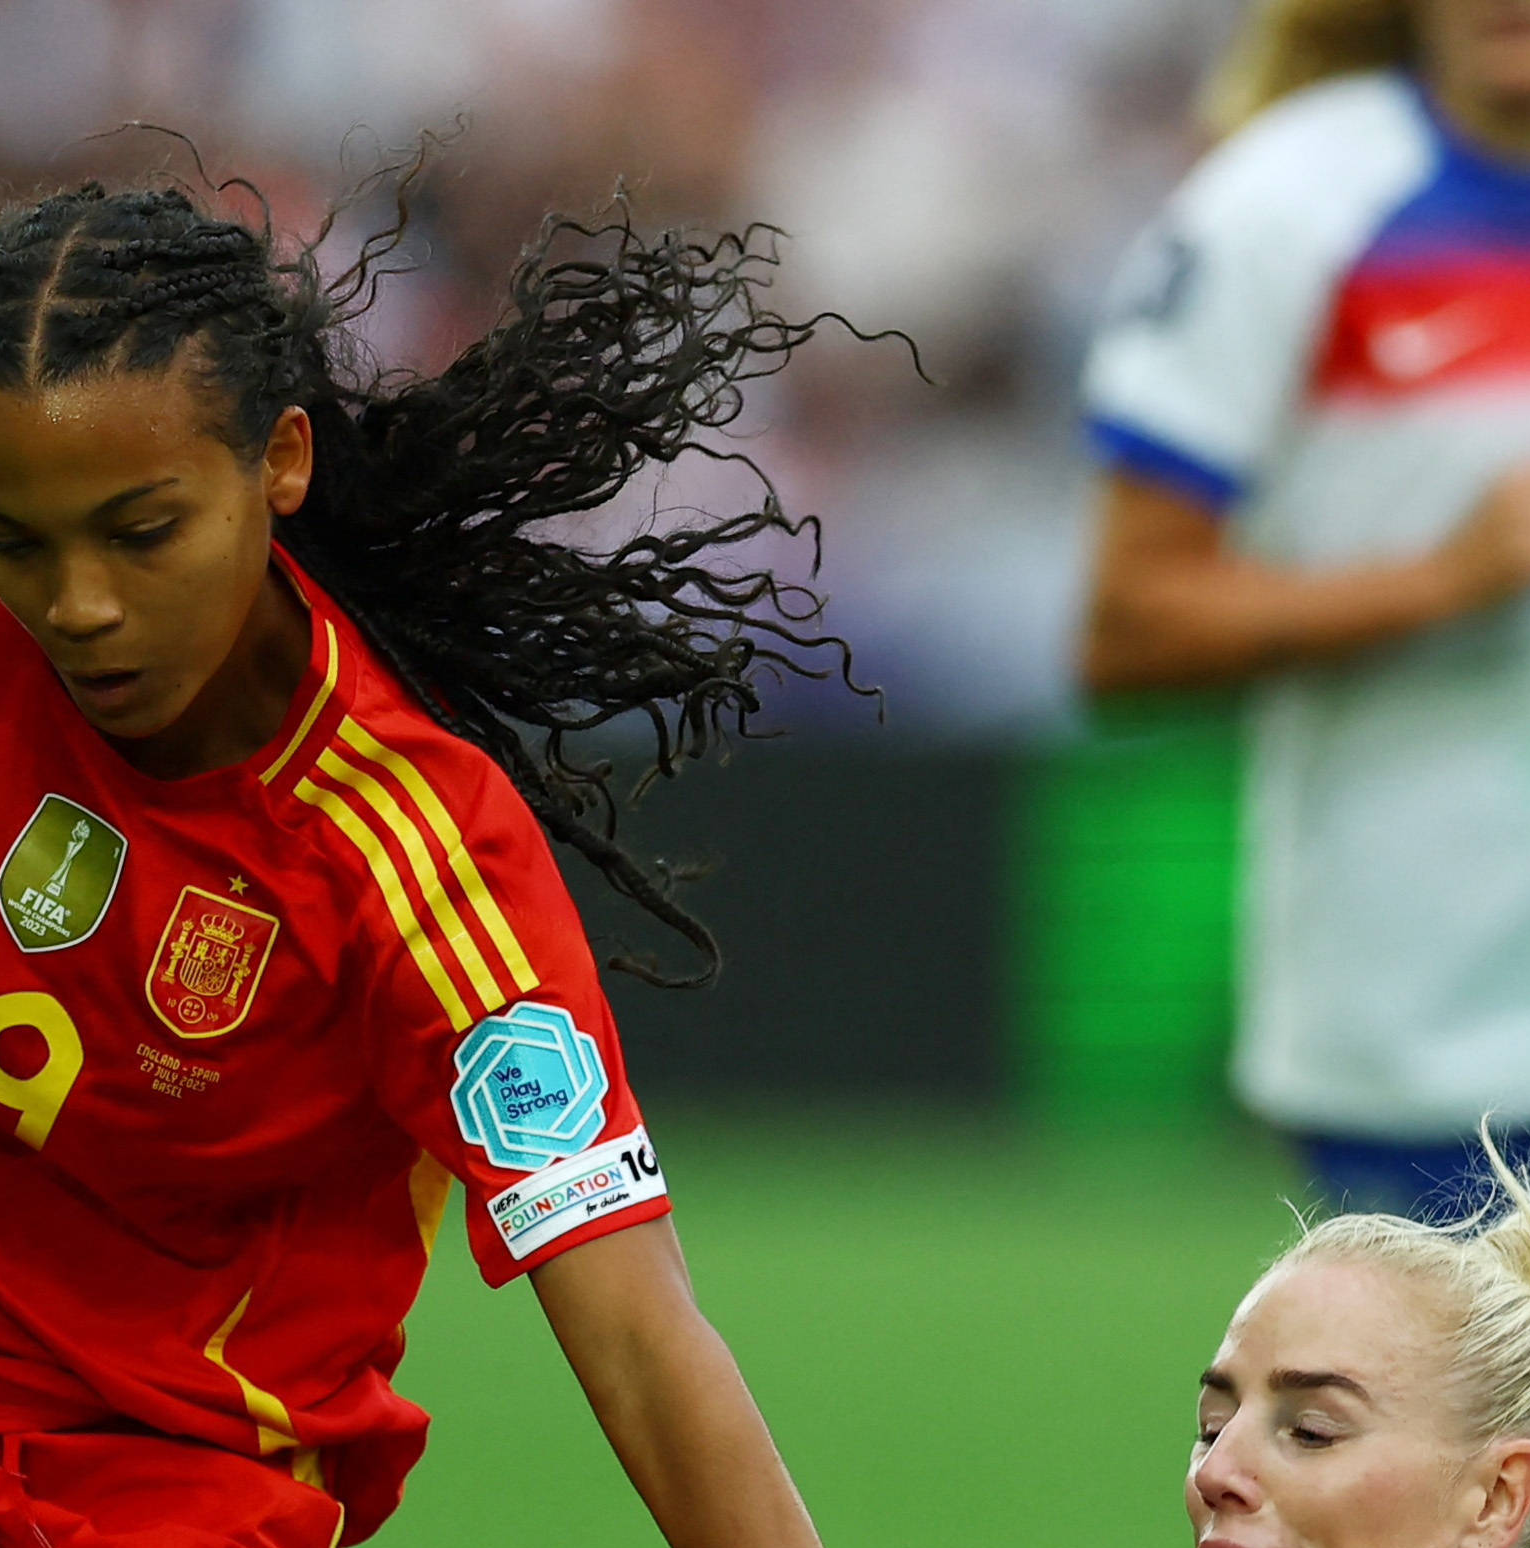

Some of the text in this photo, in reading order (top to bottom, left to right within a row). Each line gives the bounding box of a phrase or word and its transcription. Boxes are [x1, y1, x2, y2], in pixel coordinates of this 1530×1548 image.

[7, 898, 71, 938] WORLD CHAMPIONS
[20, 887, 67, 925] FIFA
[19, 915, 47, 937] 2023
[136, 1043, 181, 1070] ENGLAND
[191, 1066, 220, 1083] SPAIN
[140, 1059, 207, 1092] 27 JULY 2025
[492, 1065, 522, 1083] We
[152, 1078, 183, 1099] BASEL
[500, 1079, 542, 1103] Play
[507, 1089, 569, 1119] Strong
[493, 1191, 521, 1216] UEFA
[500, 1166, 624, 1238] FOUNDATION
[586, 1192, 631, 1217] for children
